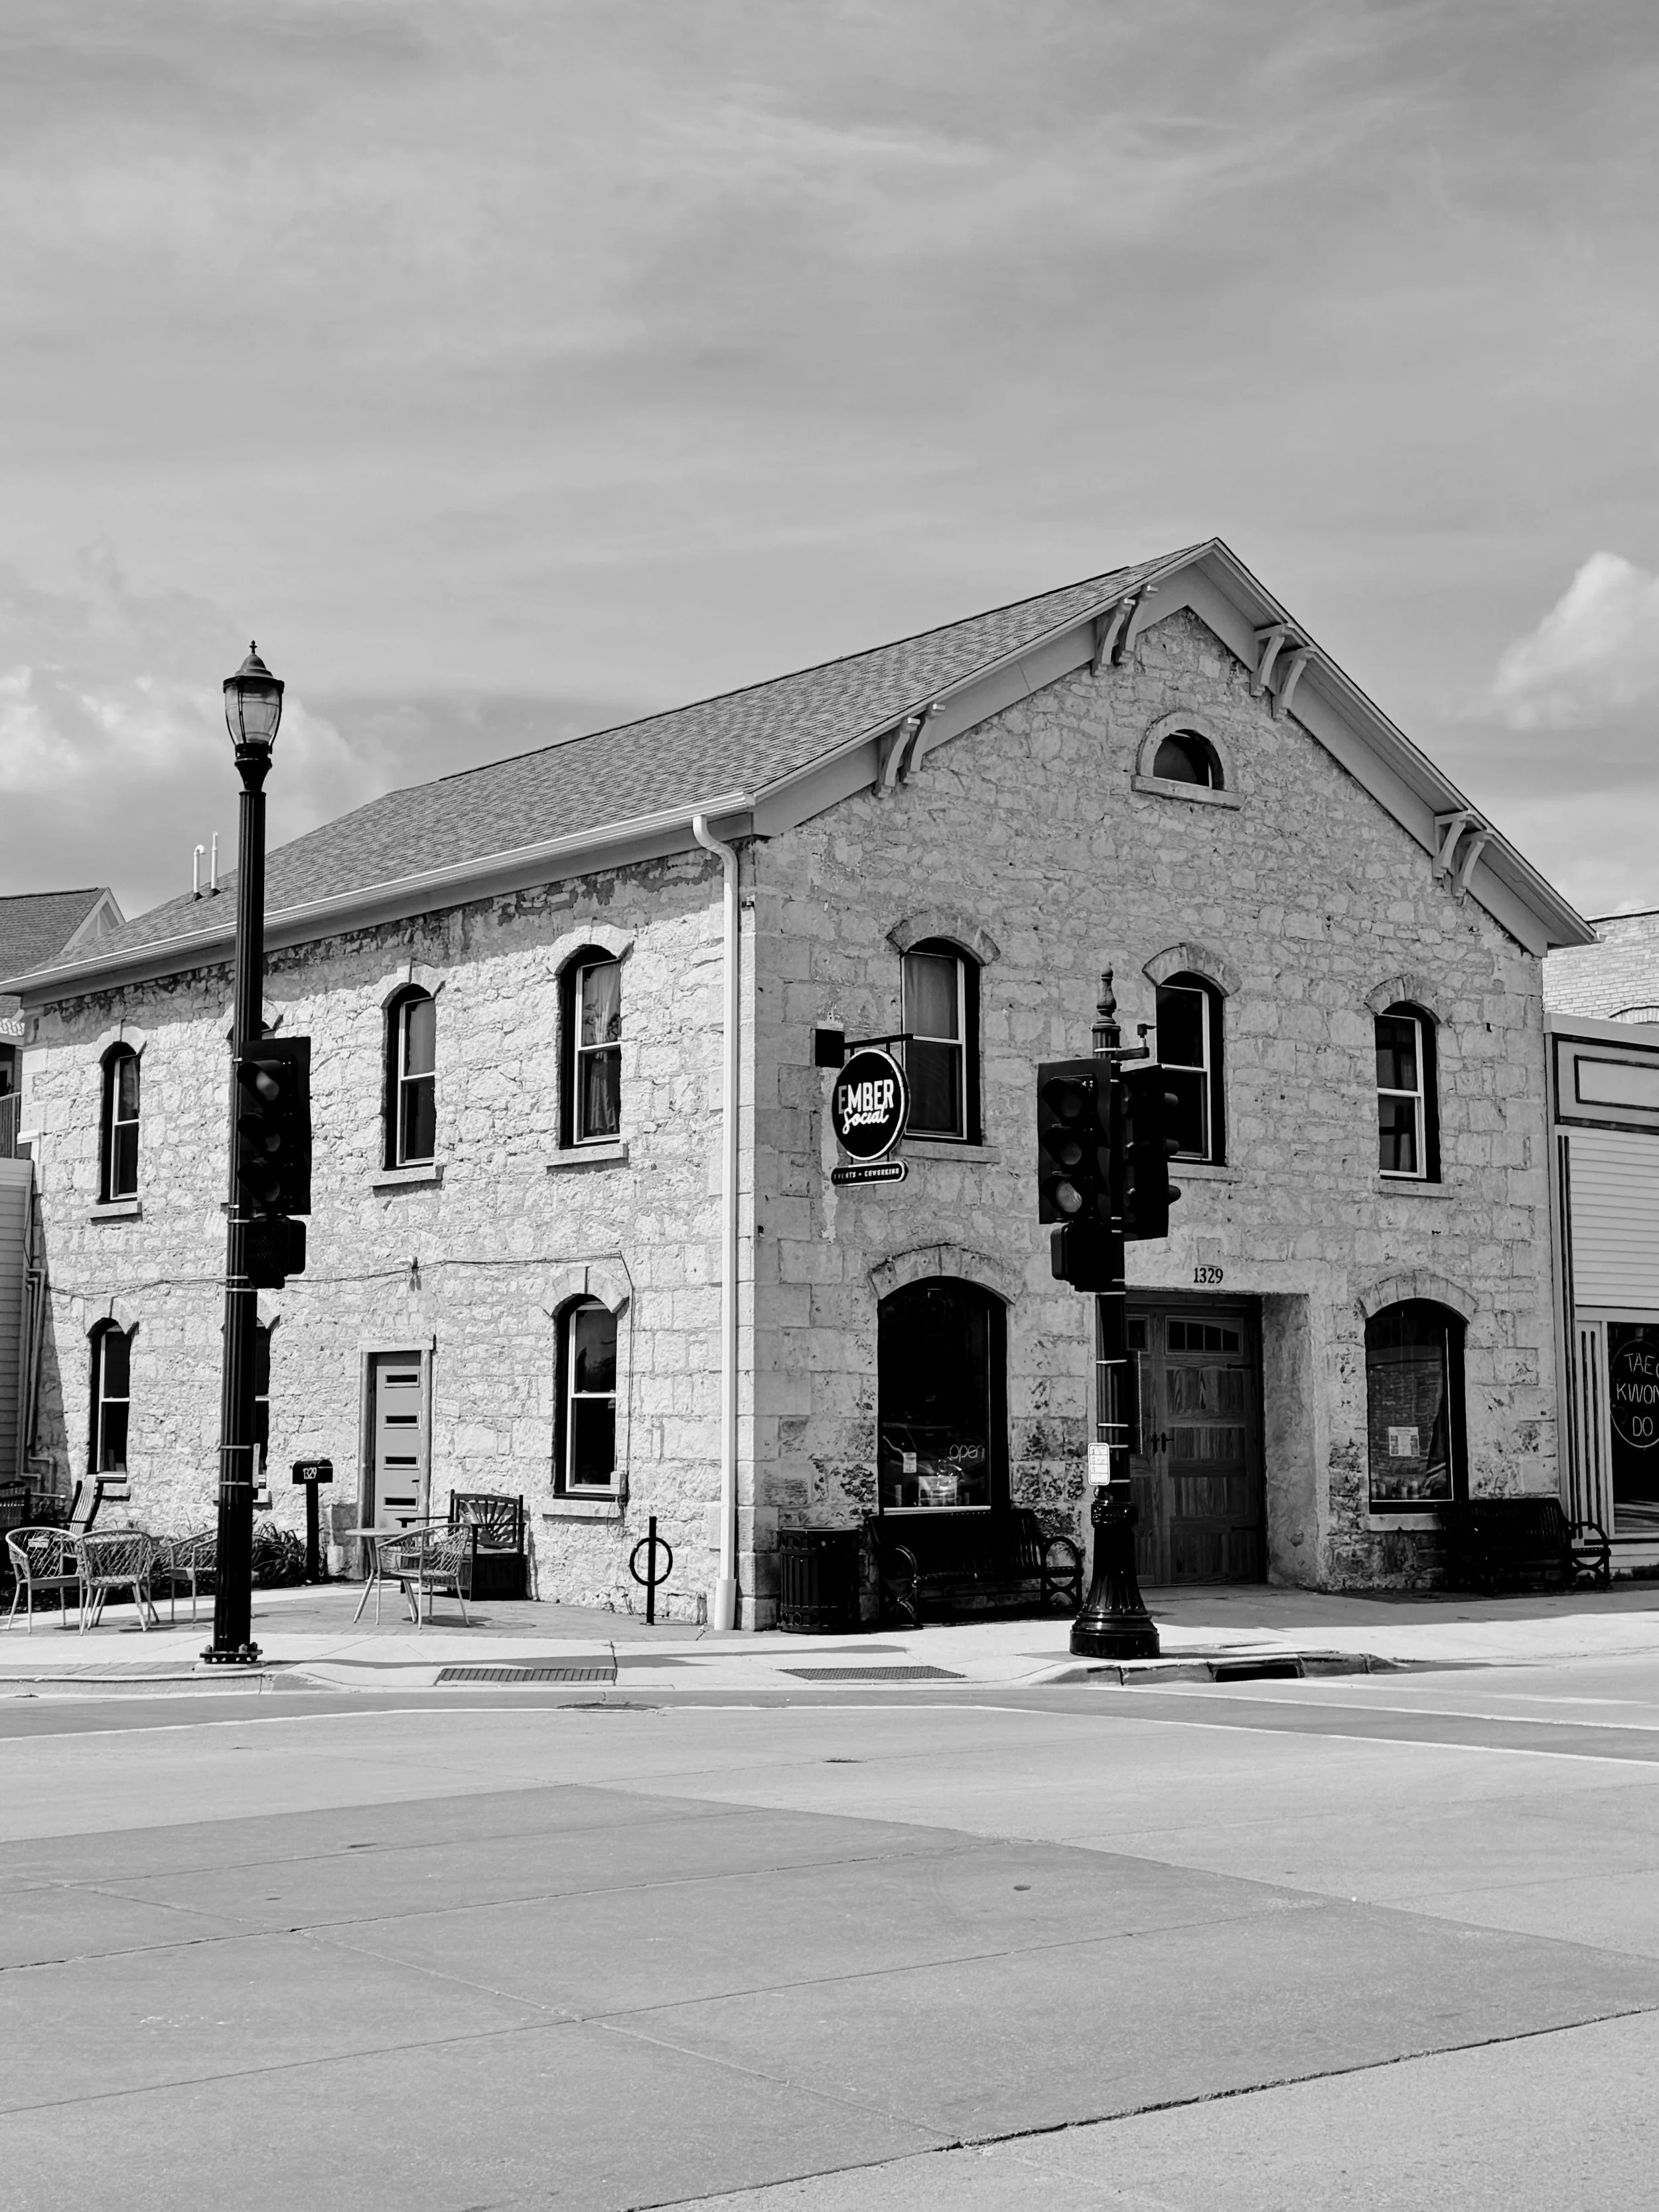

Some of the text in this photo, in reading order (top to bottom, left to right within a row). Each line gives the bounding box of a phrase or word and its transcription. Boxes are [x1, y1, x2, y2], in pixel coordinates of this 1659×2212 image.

[838, 1079, 894, 1114] EMBER
[842, 1104, 889, 1135] Social
[1193, 1267, 1224, 1284] 1329
[1624, 1353, 1655, 1375] TAE
[1632, 1416, 1653, 1436] DO
[949, 1444, 985, 1463] open
[303, 1467, 317, 1480] 1329
